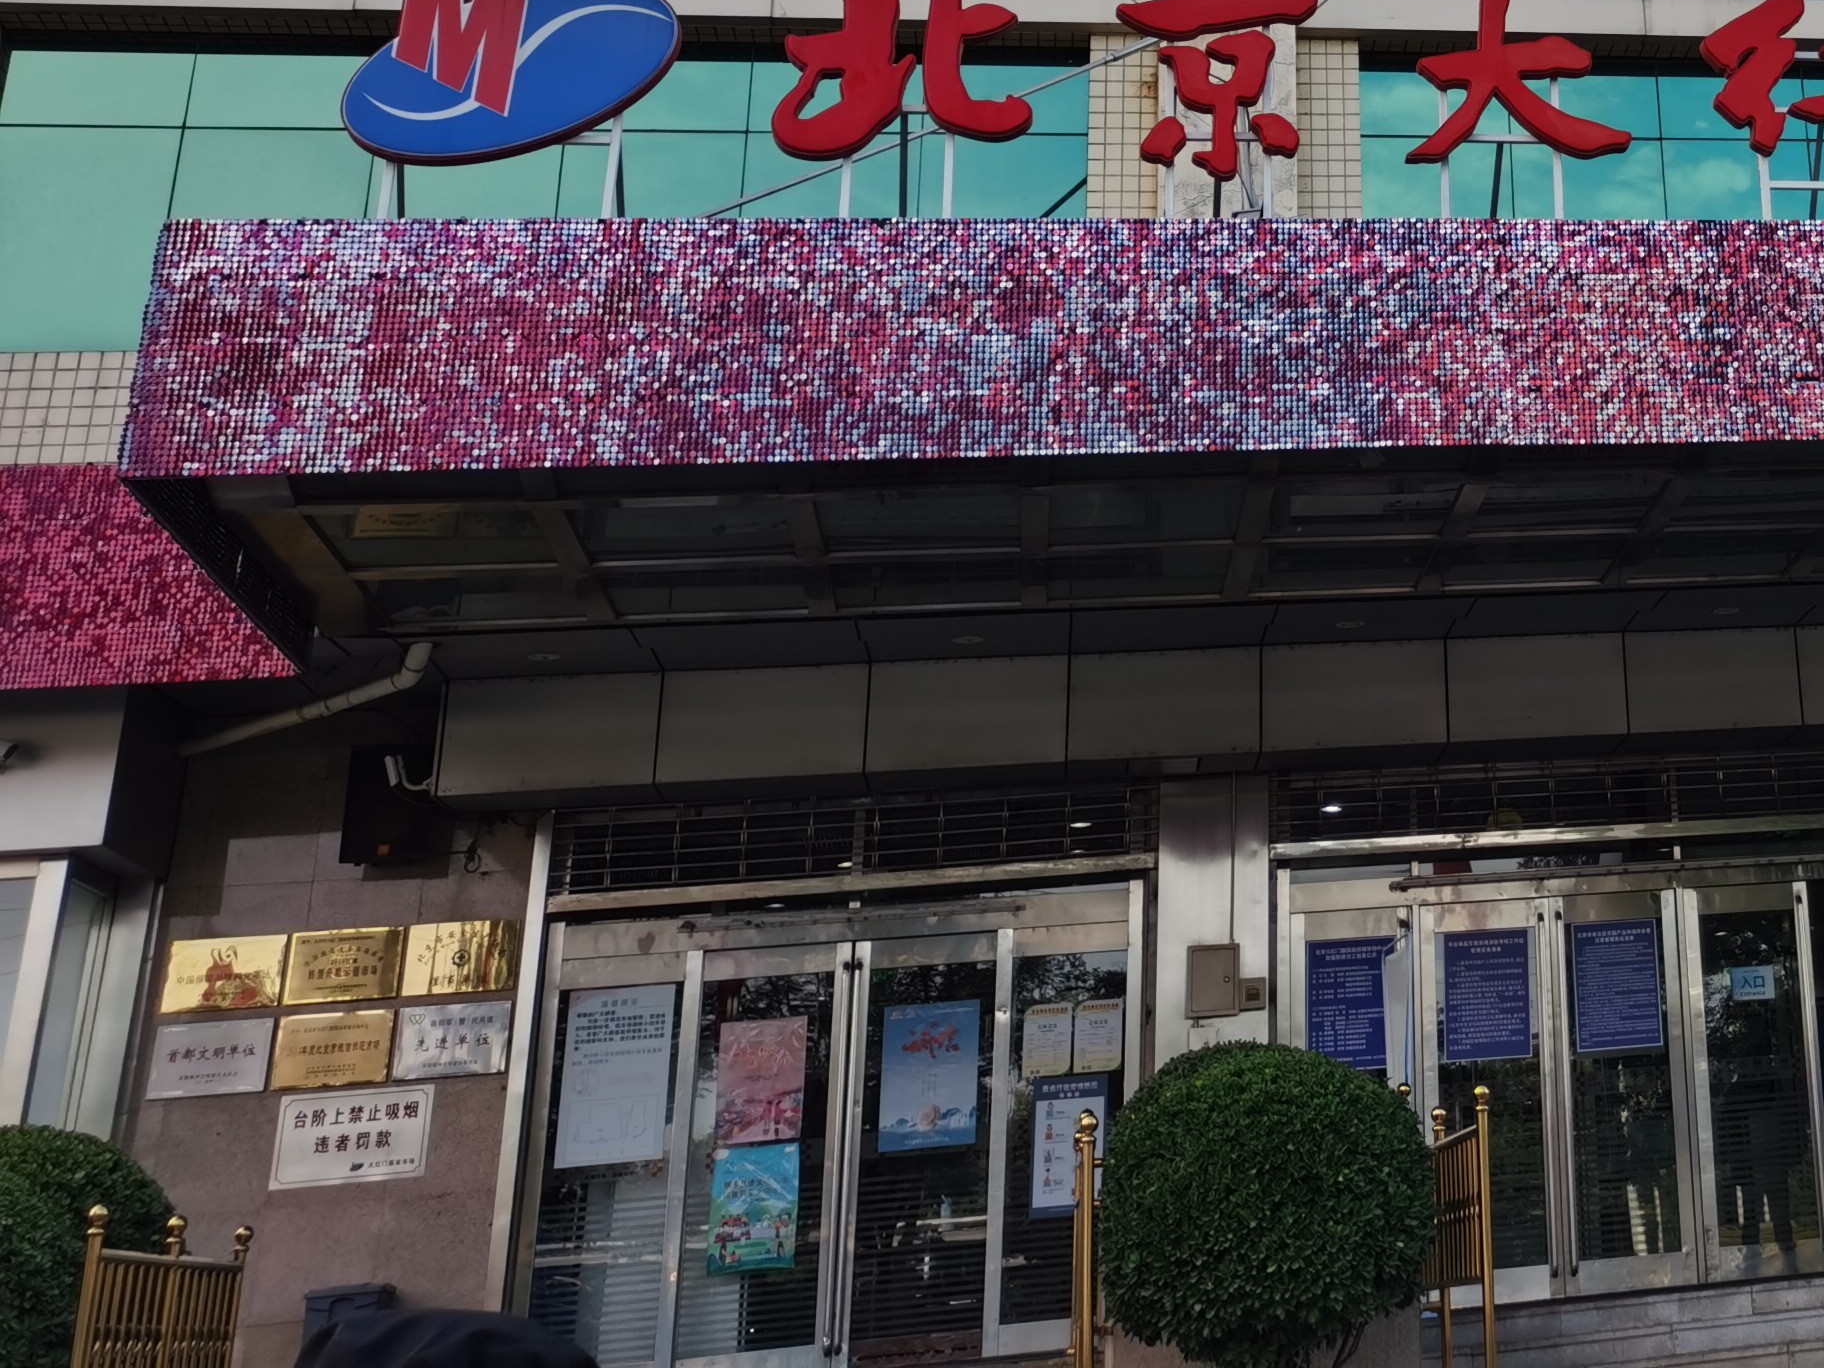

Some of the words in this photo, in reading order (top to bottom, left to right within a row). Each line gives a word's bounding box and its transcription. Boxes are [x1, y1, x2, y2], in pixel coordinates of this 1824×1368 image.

[1741, 976, 1765, 989] 入口
[167, 1043, 256, 1064] 首都文明单位
[414, 1033, 491, 1053] 先进单位
[294, 1101, 420, 1129] 台阶上禁止吸烟
[313, 1130, 392, 1155] 违者罚款
